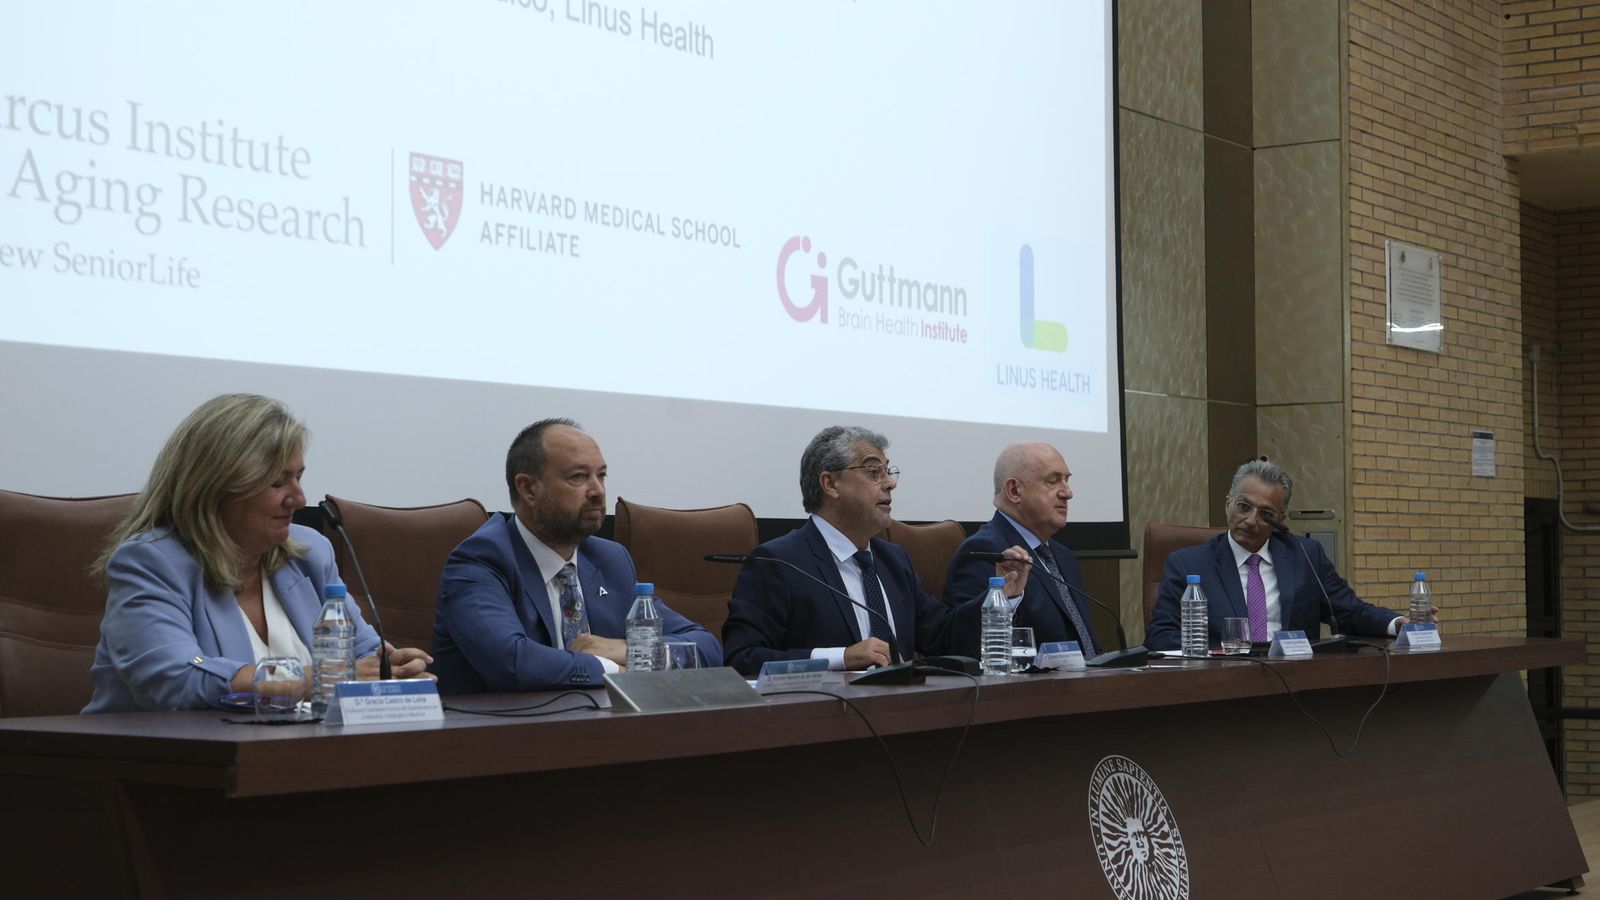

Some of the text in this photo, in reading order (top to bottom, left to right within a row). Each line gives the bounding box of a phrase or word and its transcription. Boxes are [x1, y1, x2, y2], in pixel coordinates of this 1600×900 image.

[566, 0, 632, 37] Linus
[641, 7, 714, 60] Health
[0, 94, 311, 180] rcus Institute
[7, 148, 367, 248] Aging Research
[480, 181, 741, 249] HARVARD MEDICAL SCHOOL
[53, 240, 201, 289] SeniorLife
[480, 220, 580, 258] AFFILIATE
[837, 256, 968, 317] Guttmann
[837, 306, 969, 344] Brain Health Institute
[996, 363, 1091, 395] LINUS HEALTH
[1090, 759, 1115, 805] LUMINE
[1116, 758, 1168, 817] SAPIENTIA
